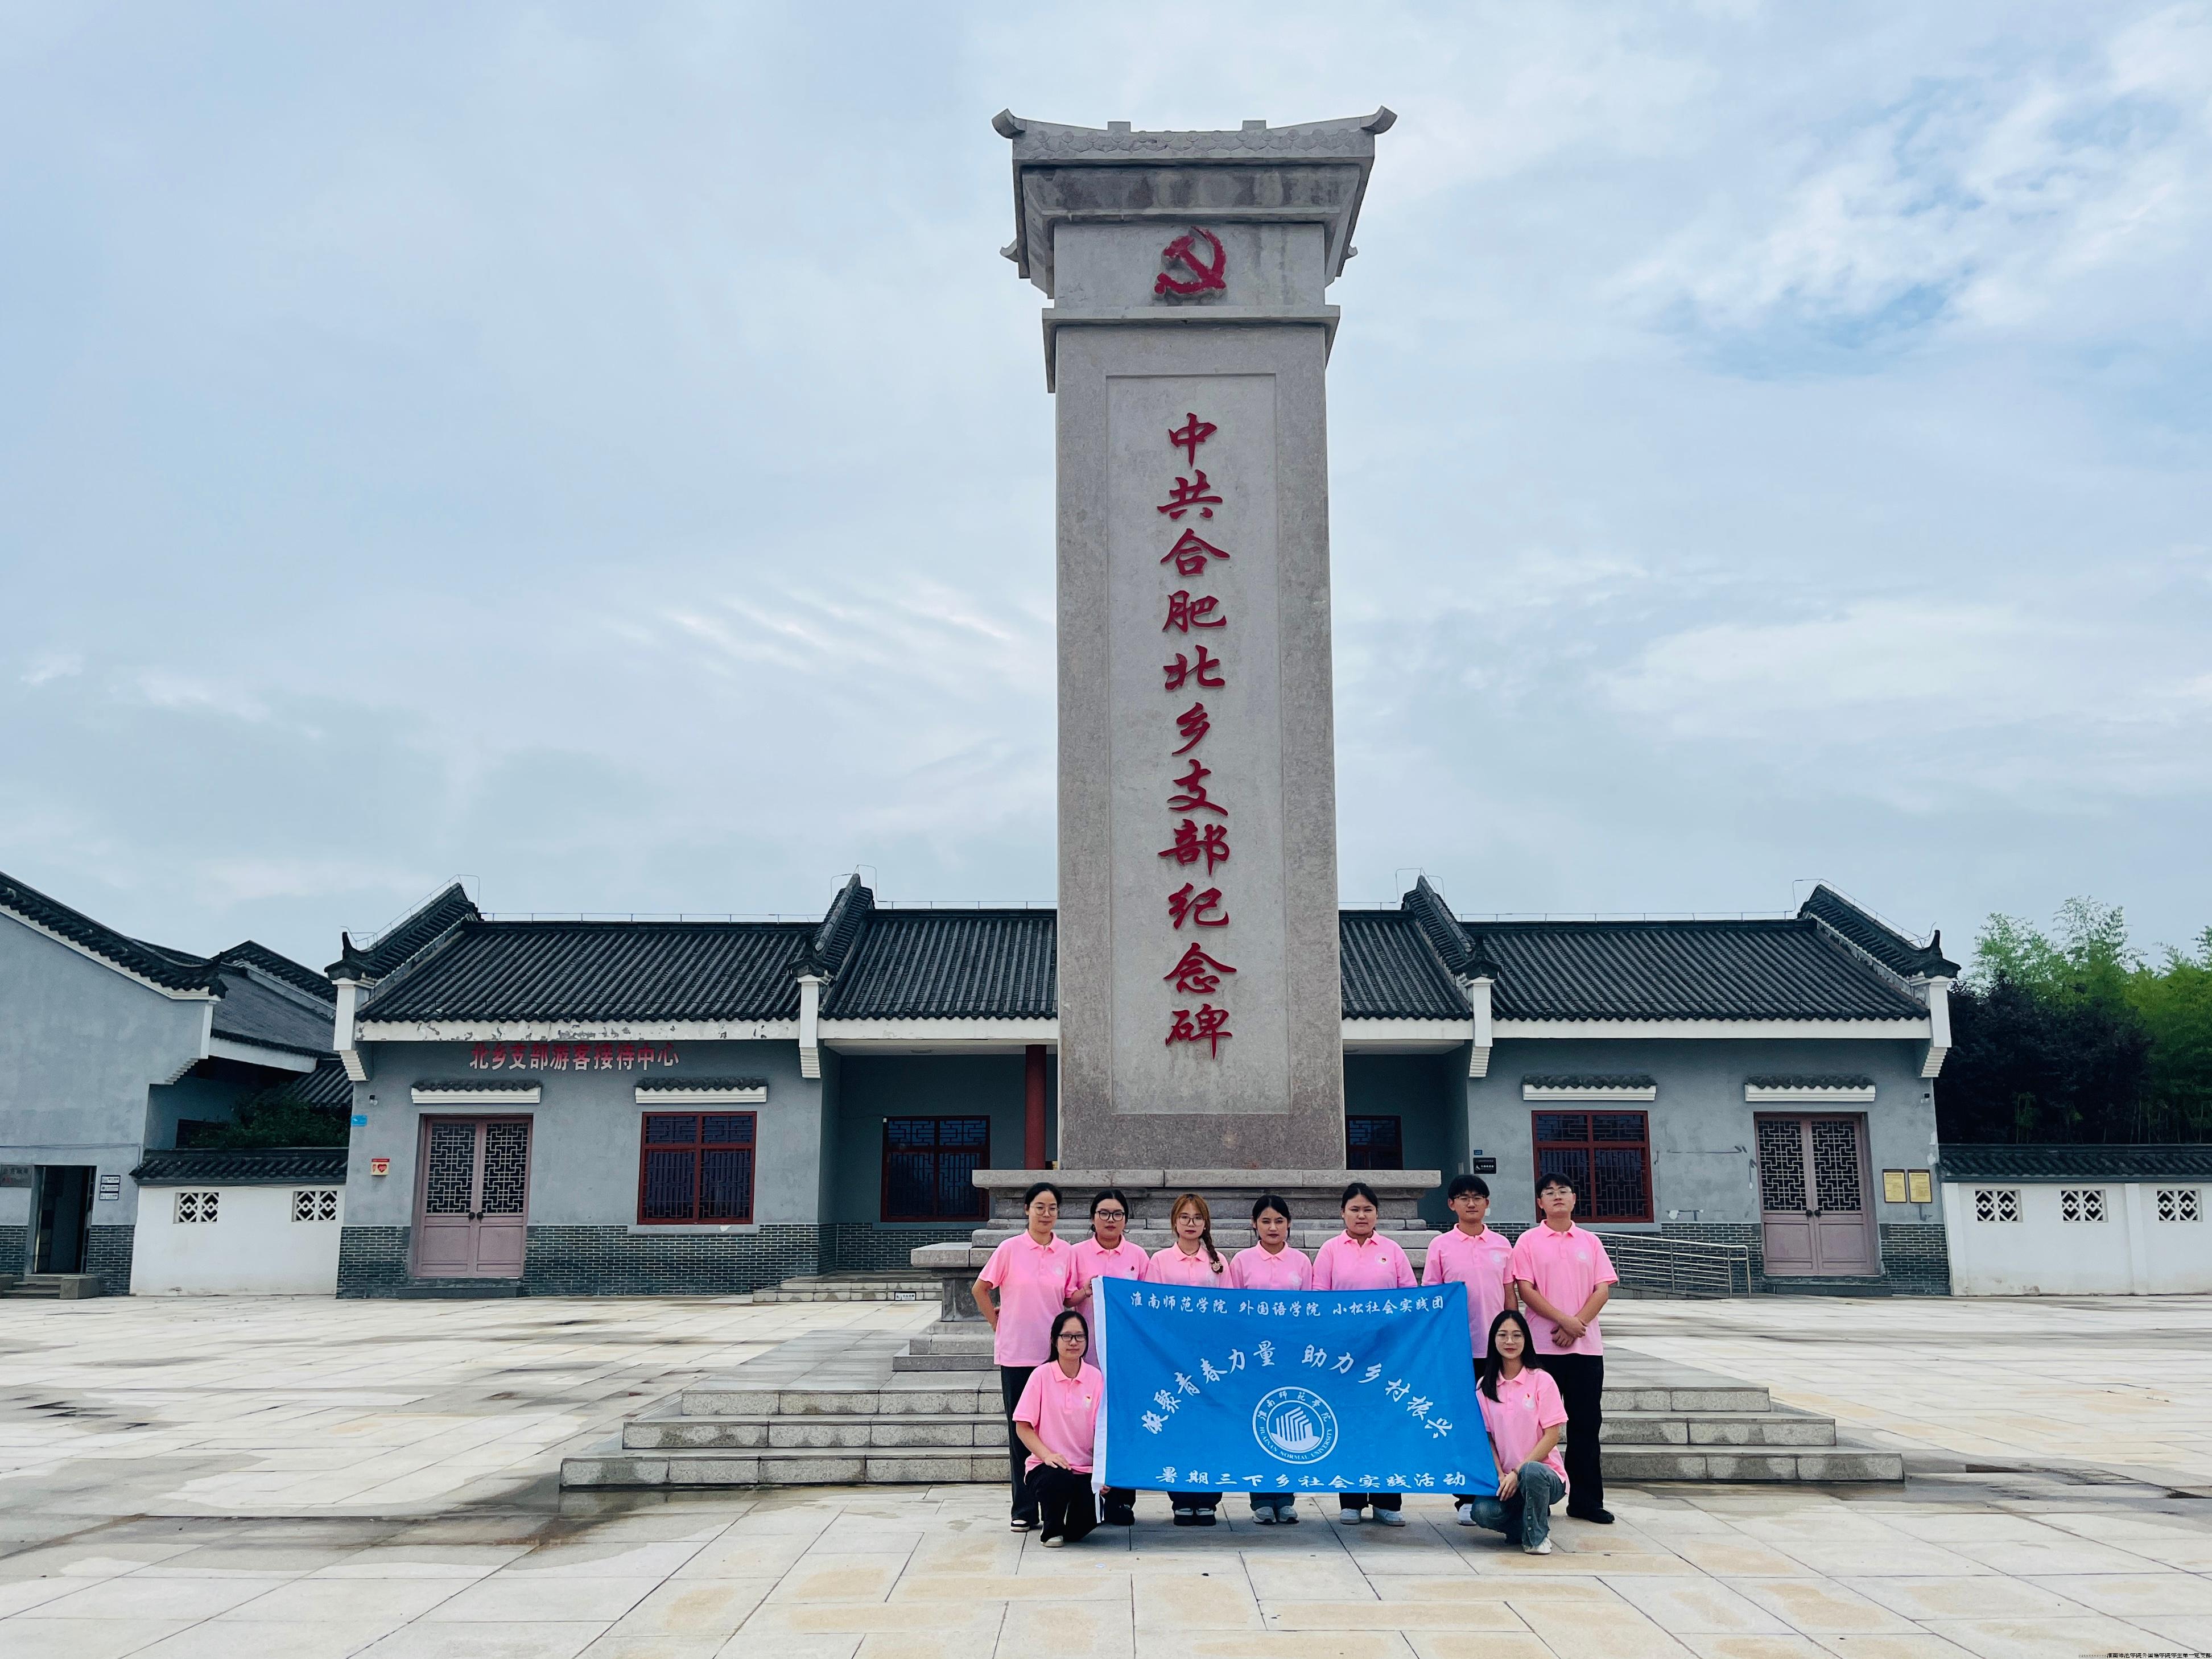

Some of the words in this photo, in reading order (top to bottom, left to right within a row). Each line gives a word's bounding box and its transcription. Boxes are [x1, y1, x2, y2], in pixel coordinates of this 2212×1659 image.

[1157, 412, 1237, 1059] 中共合肥北乡支部纪念碑
[469, 1042, 679, 1071] 北乡支部游客接待中心
[1130, 1291, 1228, 1314] 淮南师范学院
[1239, 1299, 1321, 1317] 外国语学院
[1332, 1295, 1444, 1315] 小松社会实践团
[1141, 1340, 1276, 1434] 凝聚青春力量
[1301, 1344, 1454, 1439] 助力乡村振兴
[1259, 1426, 1278, 1452] HUAINAN
[1280, 1451, 1309, 1460] NORMAL
[1310, 1428, 1333, 1458] UNIVERSITY
[1155, 1466, 1466, 1488] 暑期三下乡社会实践活动
